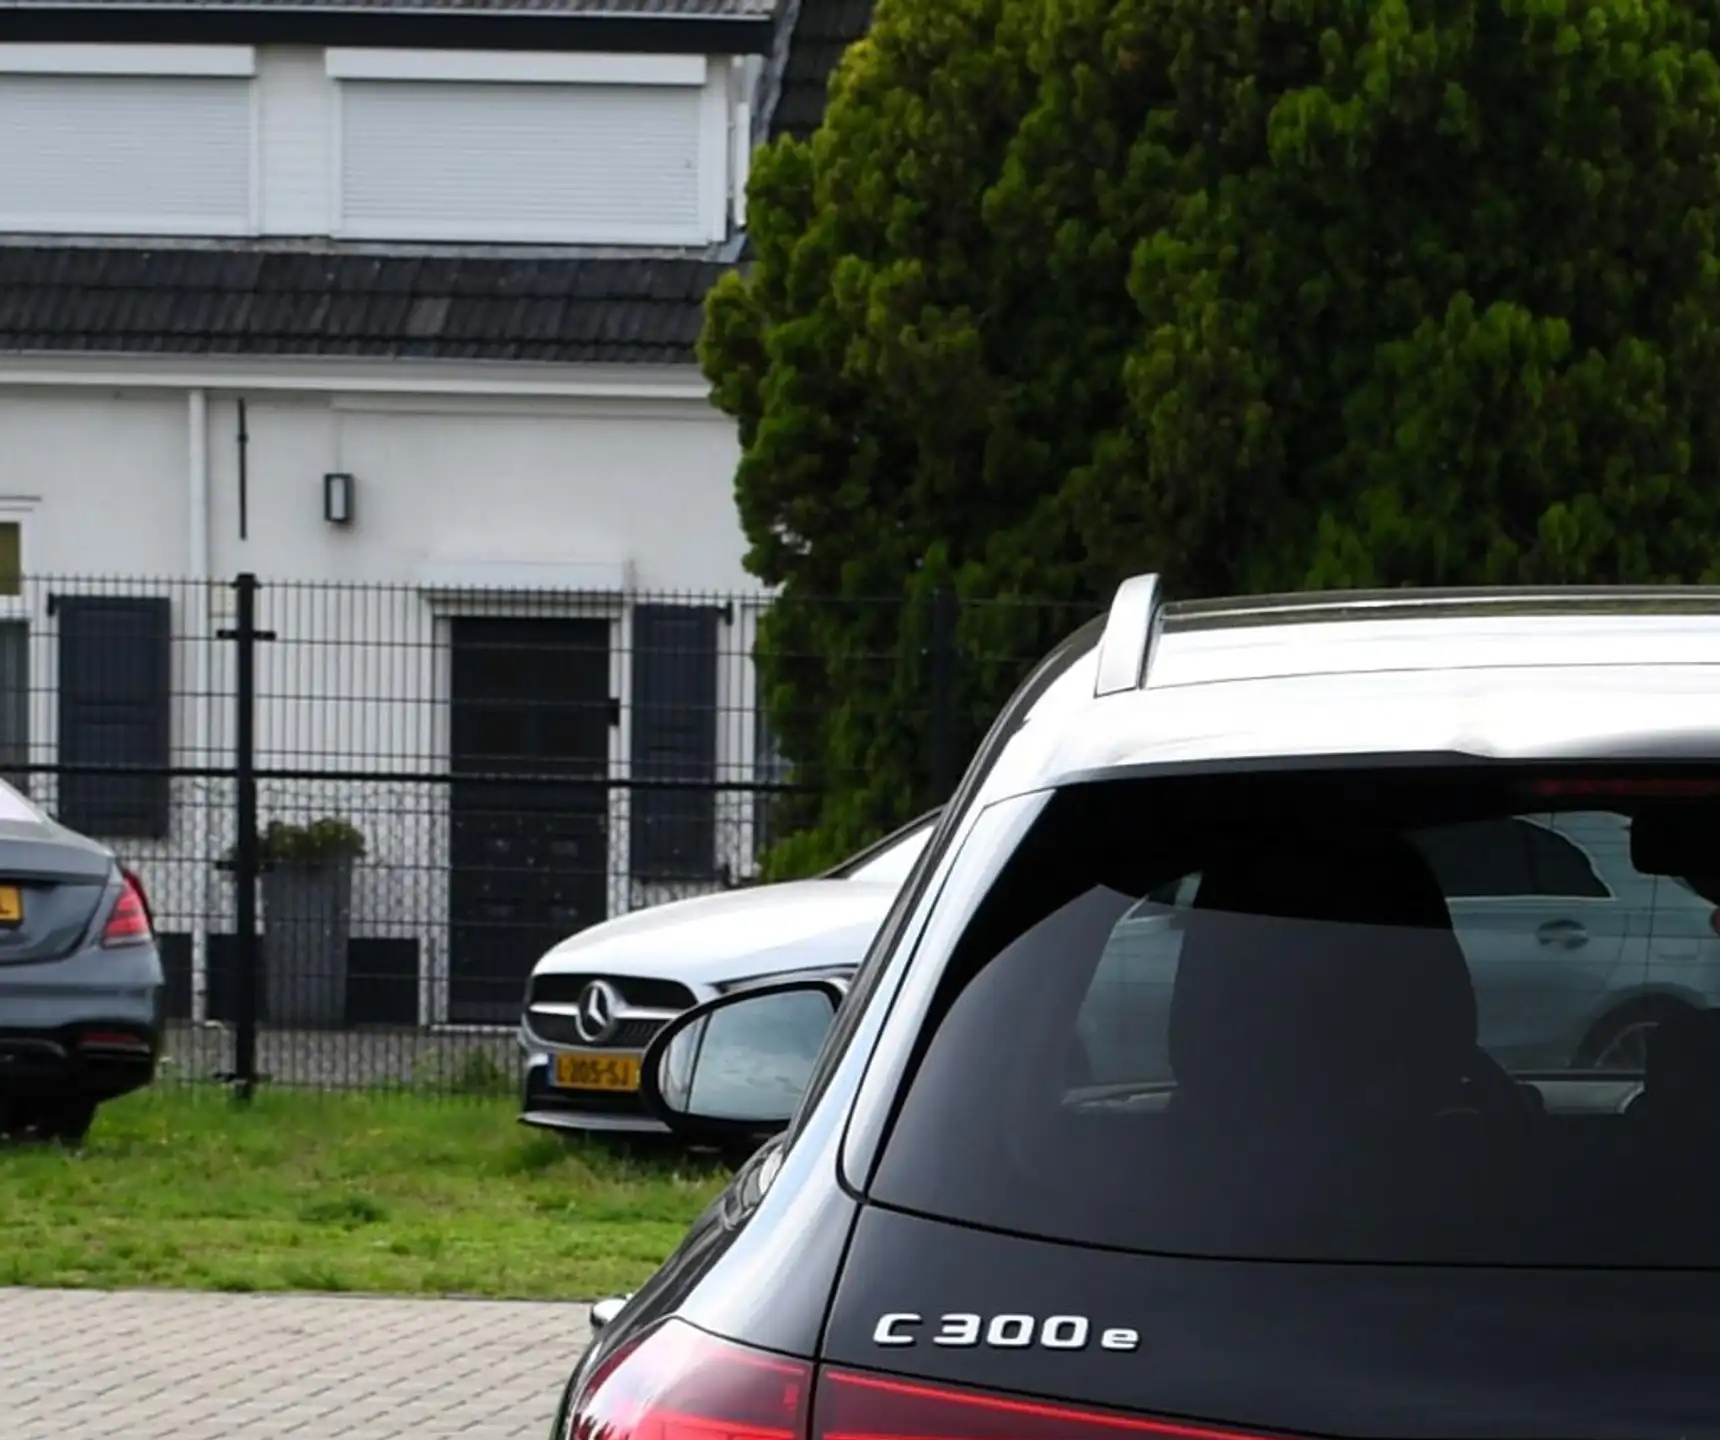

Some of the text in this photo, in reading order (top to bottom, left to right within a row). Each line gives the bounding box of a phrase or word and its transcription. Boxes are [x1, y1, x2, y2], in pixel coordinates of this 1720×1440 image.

[872, 1312, 1140, 1350] C 300 e
